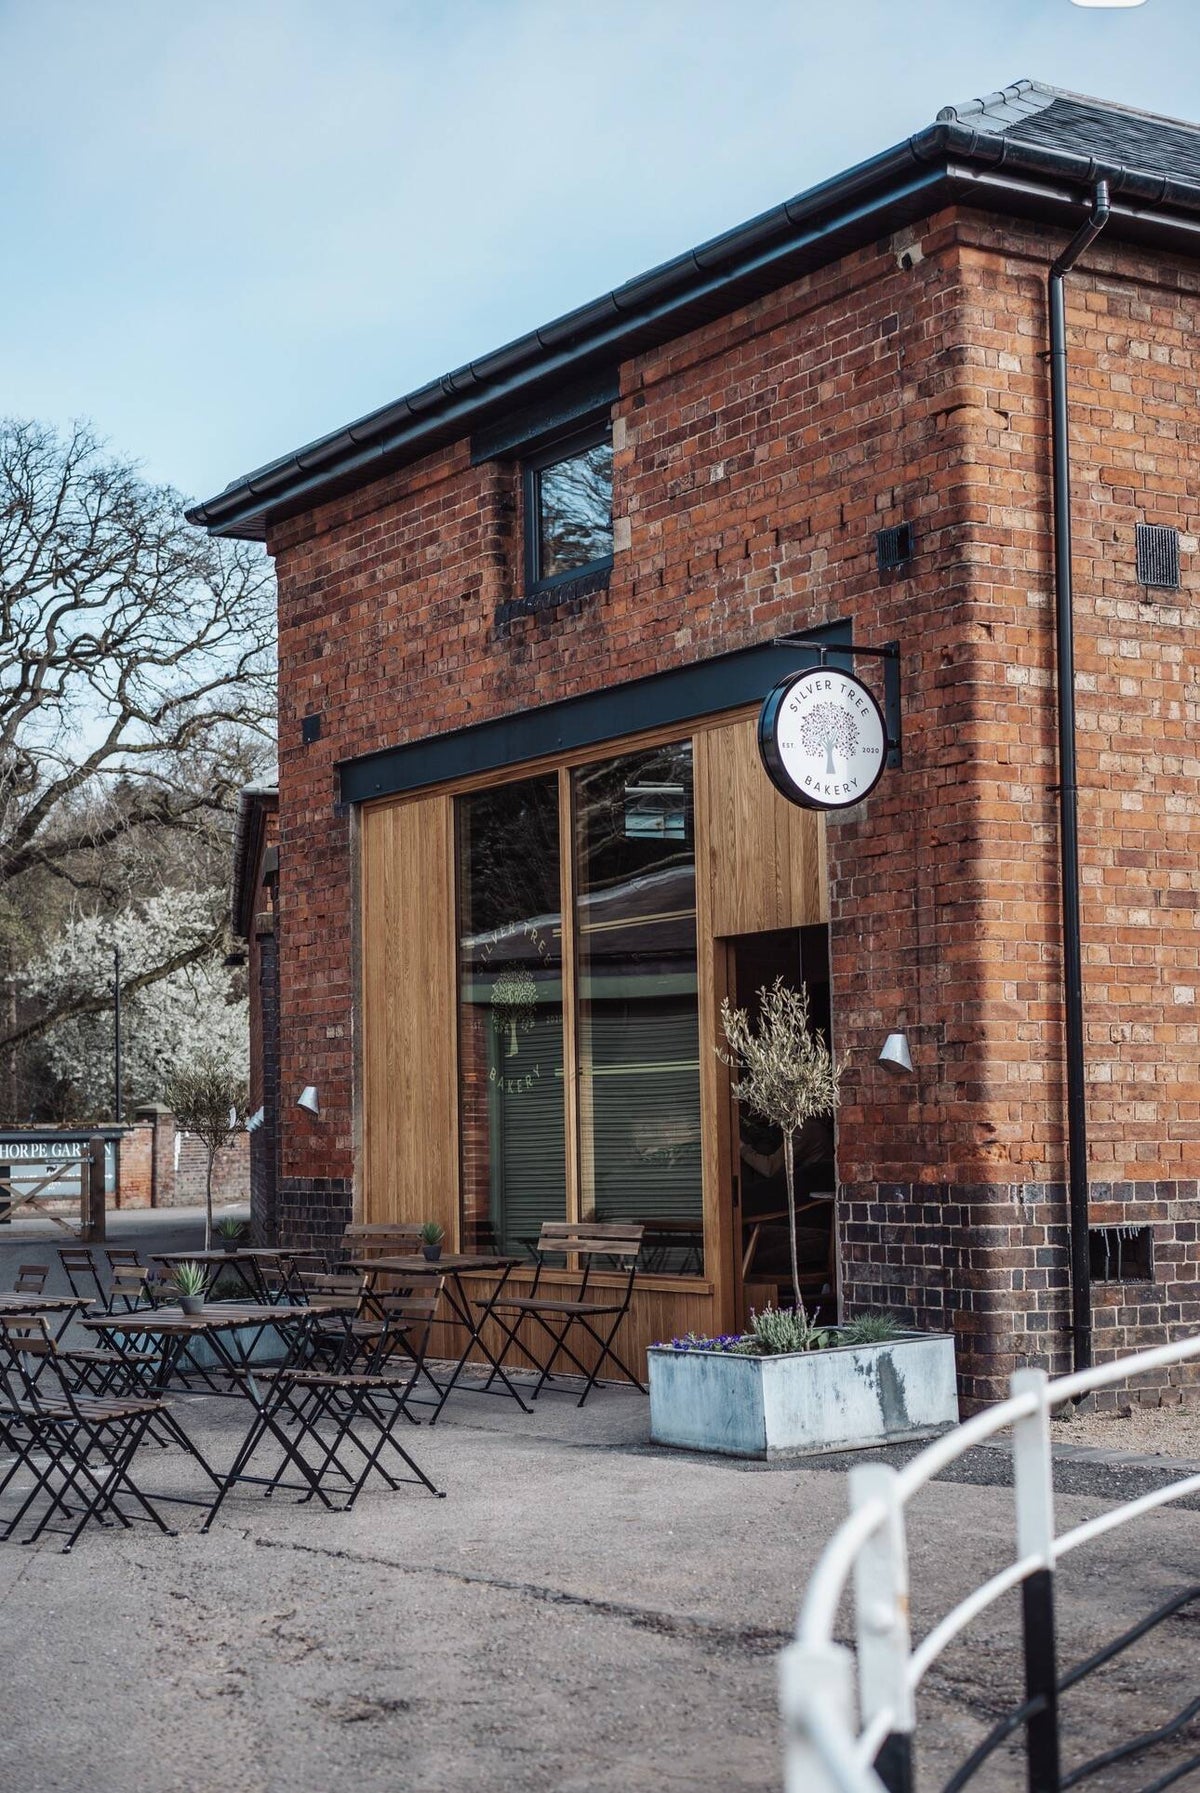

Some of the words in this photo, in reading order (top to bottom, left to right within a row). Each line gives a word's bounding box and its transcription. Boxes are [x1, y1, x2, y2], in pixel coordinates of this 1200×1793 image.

[789, 679, 832, 713] SILVER
[840, 683, 870, 718] TREE
[804, 775, 858, 796] BAKERY
[523, 922, 551, 967] TREE
[489, 1063, 541, 1094] BAKERY
[51, 1142, 112, 1158] GARN
